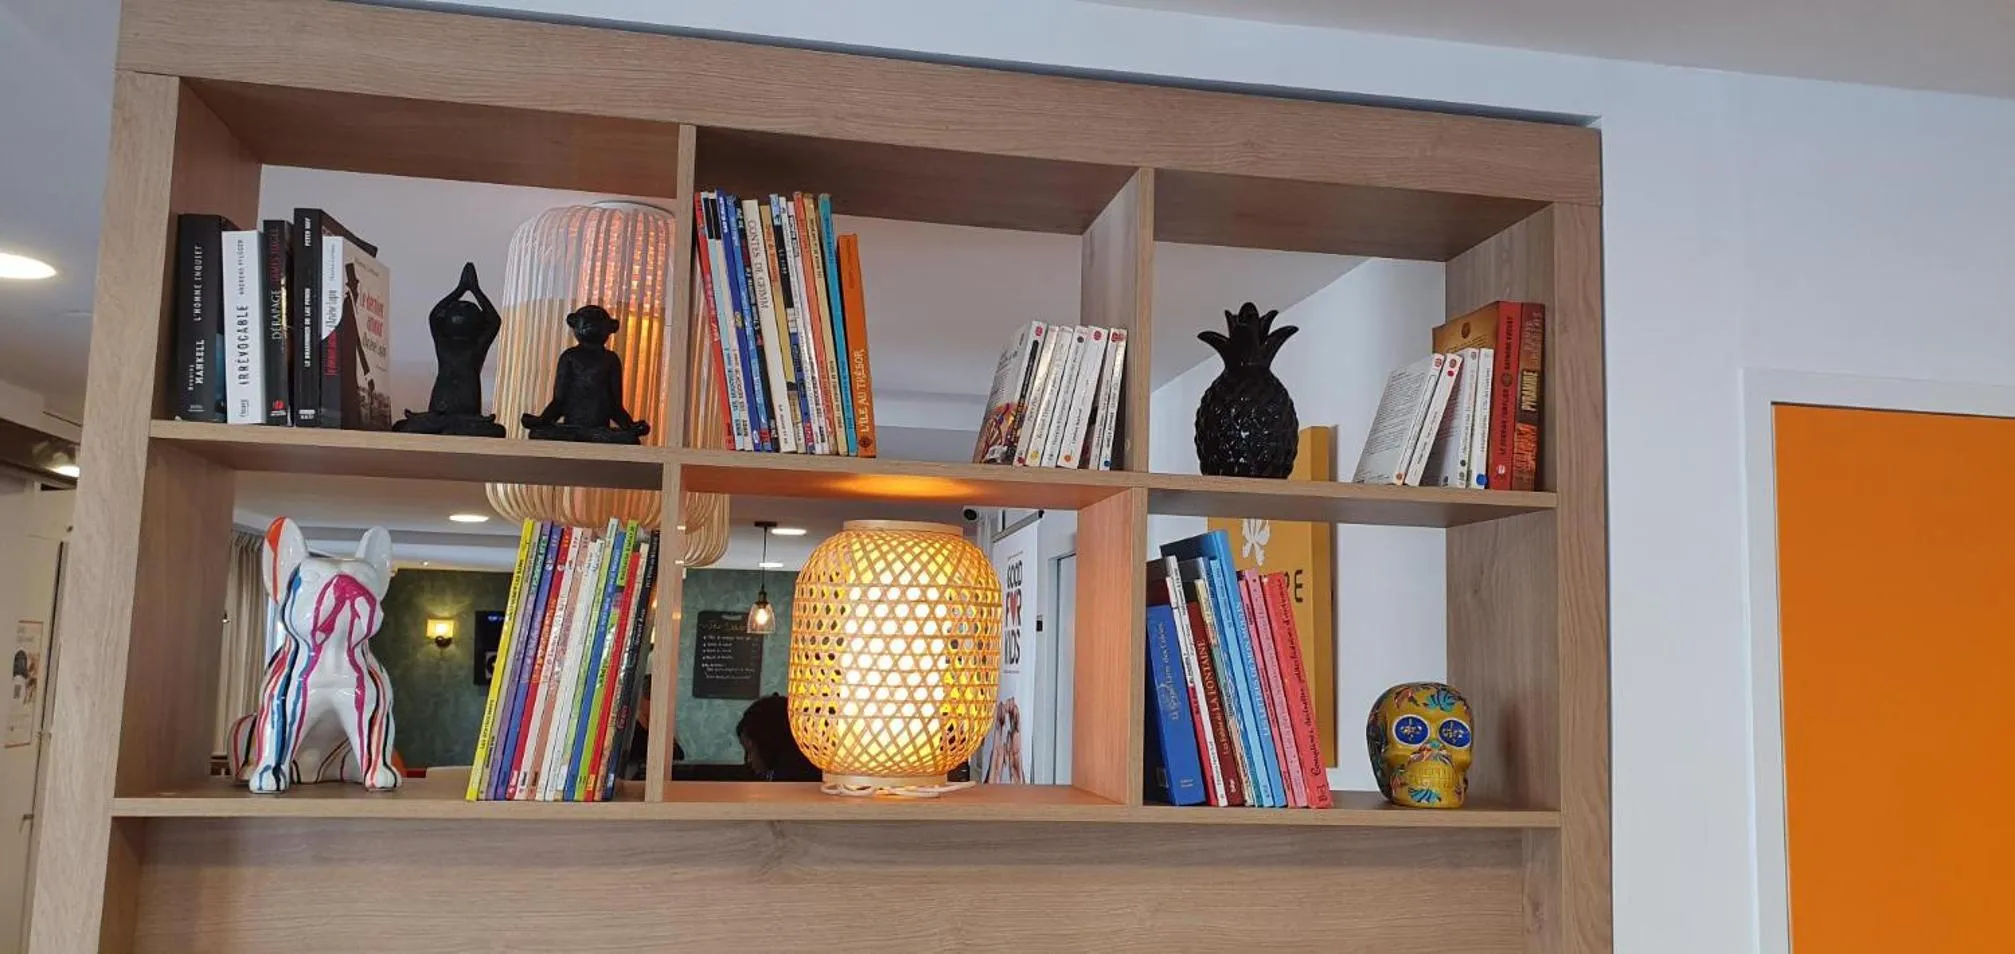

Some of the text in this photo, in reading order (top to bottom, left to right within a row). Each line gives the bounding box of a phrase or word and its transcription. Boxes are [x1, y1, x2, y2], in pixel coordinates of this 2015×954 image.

[748, 219, 762, 257] CONTES
[193, 284, 203, 321] L'HOMME
[270, 289, 282, 340] DÉRAPAGE
[195, 339, 205, 385] MANKELL
[235, 304, 250, 386] IRRÉVOCABLE
[853, 348, 867, 391] TRÉSOR
[1520, 369, 1537, 412] PYRAMIDE
[857, 391, 870, 406] AU
[1197, 639, 1217, 697] FONTAINE
[1209, 698, 1221, 712] LA
